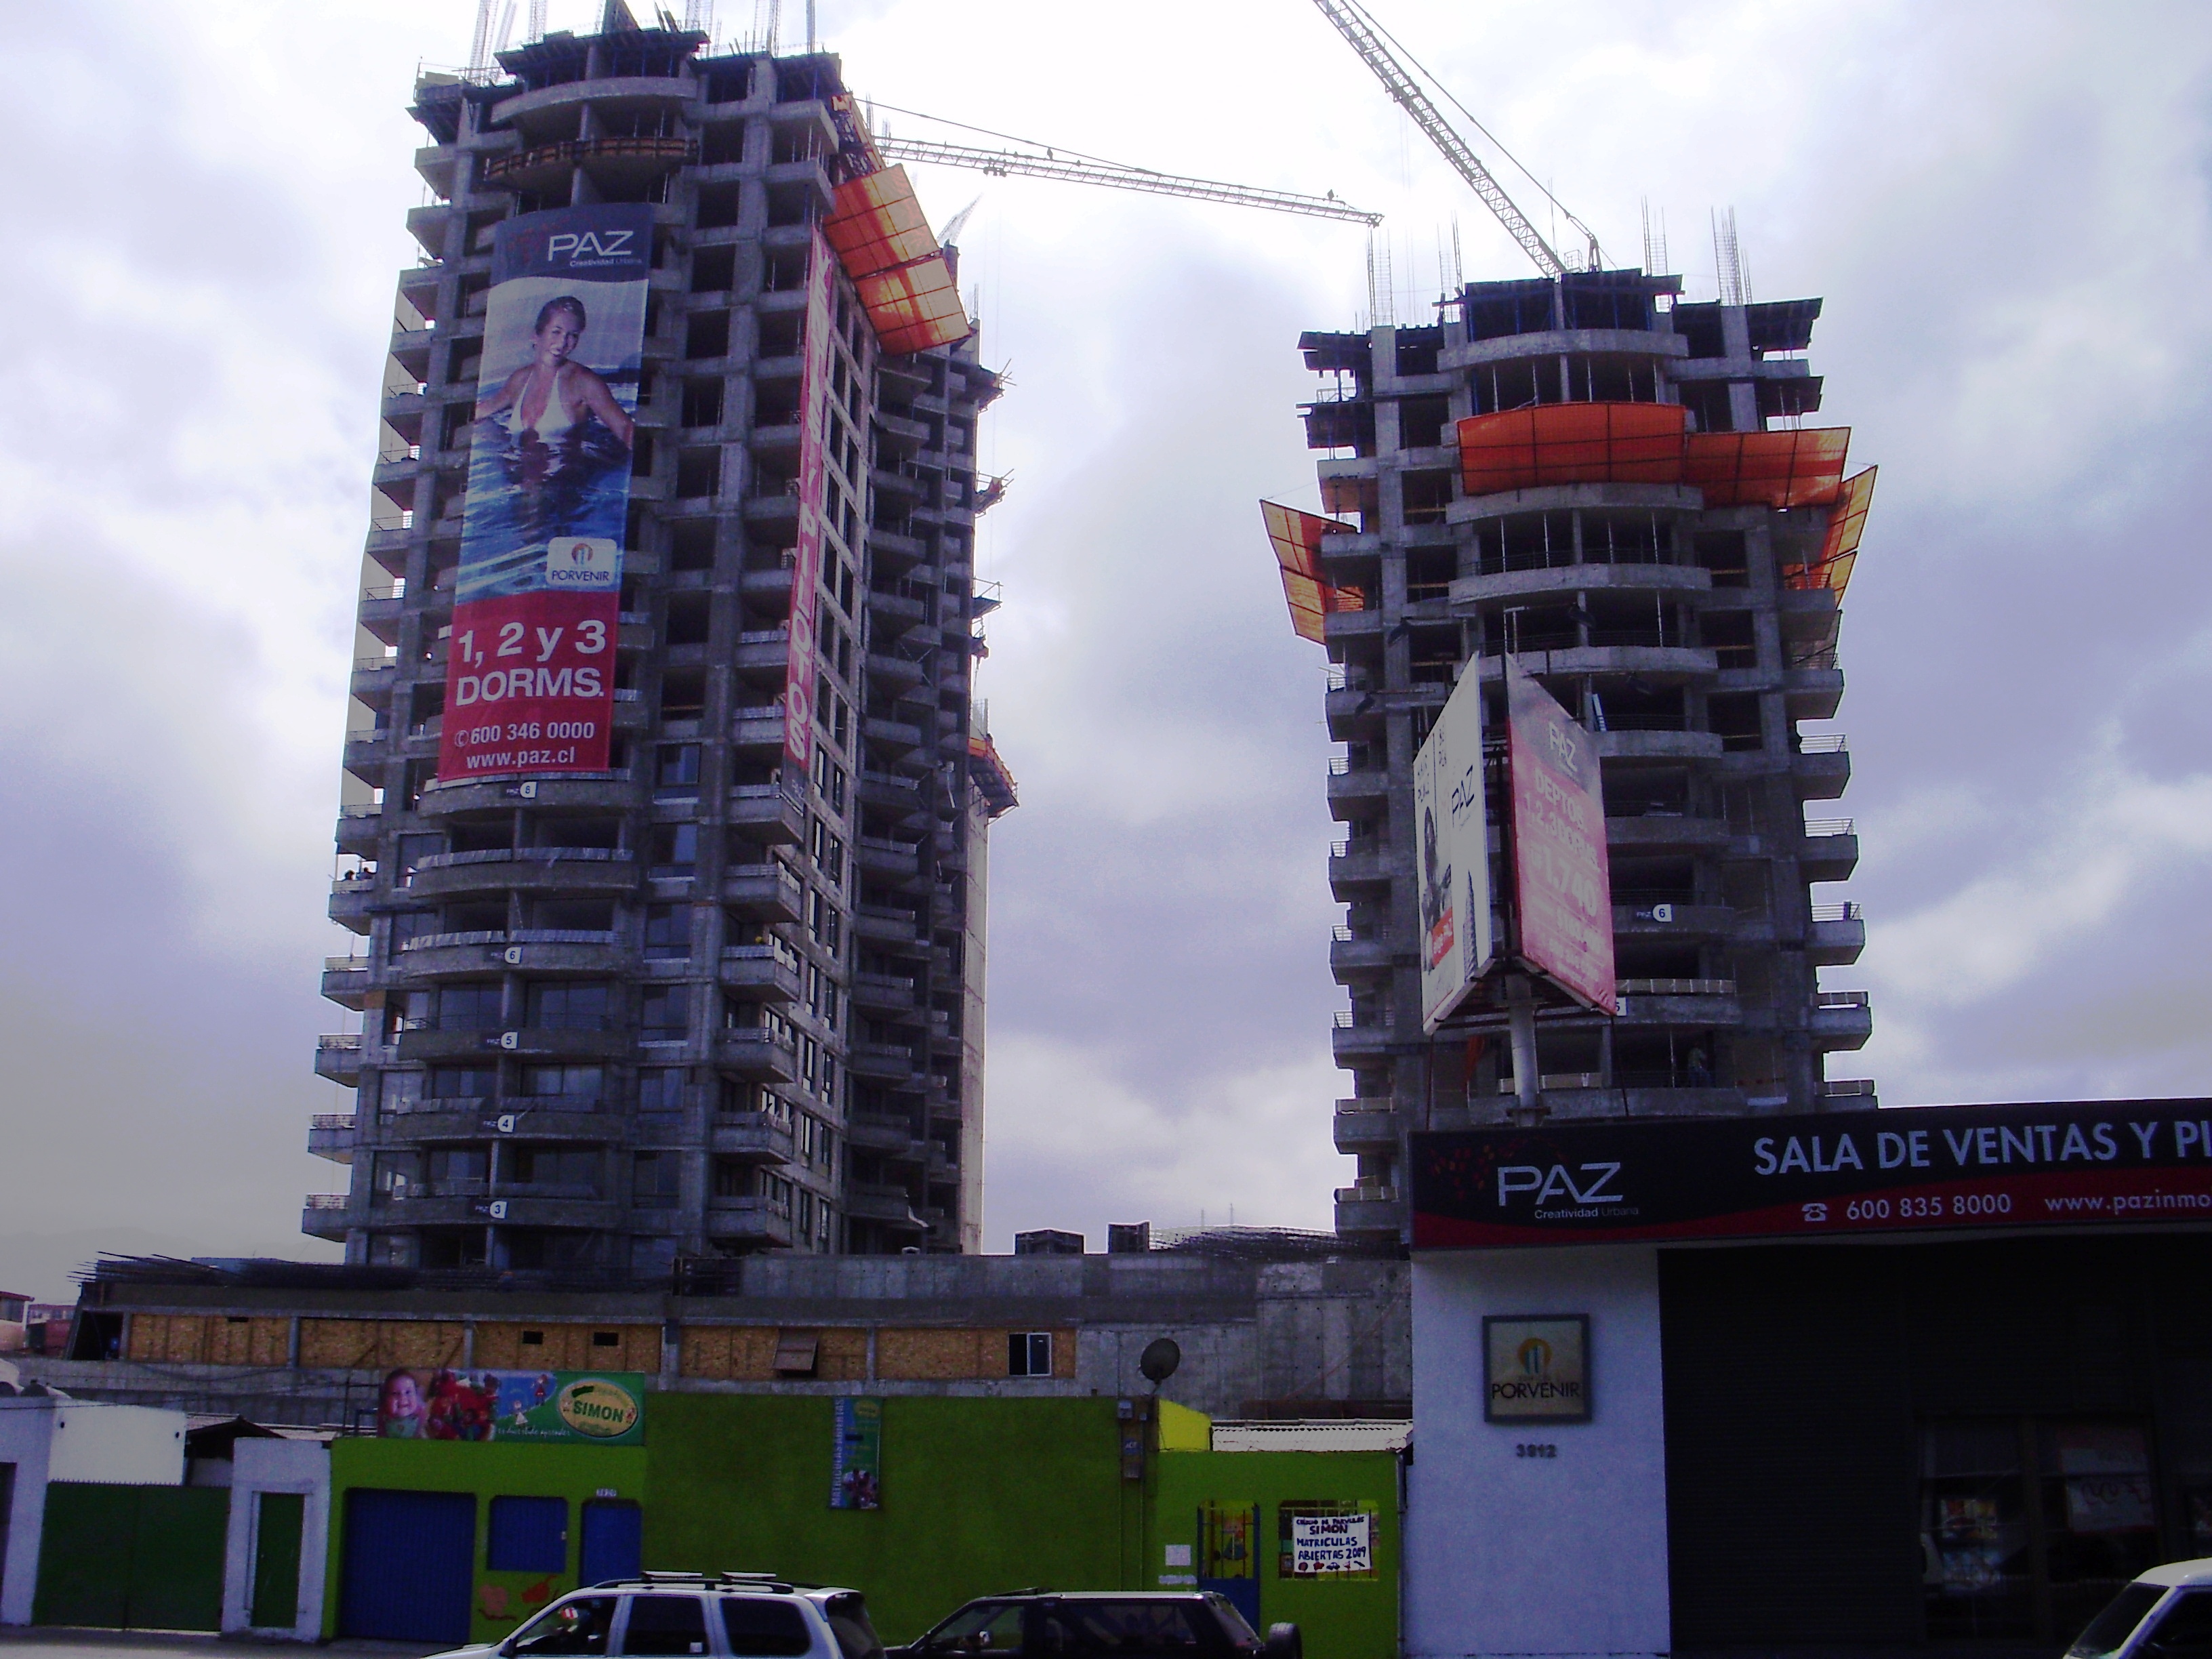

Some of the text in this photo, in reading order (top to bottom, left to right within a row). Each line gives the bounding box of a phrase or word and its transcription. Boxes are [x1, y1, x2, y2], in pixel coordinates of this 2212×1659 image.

[548, 230, 634, 262] PAZ
[552, 569, 609, 582] PORVENIR
[458, 619, 607, 668] 1, 2 y 3
[455, 667, 605, 706] DORMS.
[507, 723, 541, 741] 346
[547, 722, 595, 739] 0000
[1549, 721, 1578, 773] PAZ
[466, 746, 575, 769] www.paz.cl
[525, 785, 531, 794] 8
[1452, 765, 1475, 828] PAZ
[1658, 908, 1666, 918] 6
[510, 950, 516, 960] 6
[506, 1036, 512, 1045] 5
[502, 1118, 509, 1128] 4
[1753, 1134, 1864, 1176] SALA
[1877, 1129, 1931, 1170] DE
[1942, 1122, 2118, 1166] VENTAS
[2129, 1121, 2158, 1159] Y
[1497, 1162, 1624, 1207] PAZ
[494, 1204, 501, 1214] 3
[1534, 1208, 1599, 1219] Creatividad
[1845, 1198, 1890, 1221] 600
[1899, 1196, 1943, 1218] 835
[1952, 1193, 2011, 1215] 8000
[1491, 1382, 1581, 1399] PORVENIR
[573, 1400, 624, 1423] SIMON
[1309, 1524, 1348, 1535] SIMON
[1296, 1536, 1358, 1547] MATRICULAS
[1298, 1546, 1366, 1561] ABIERTAS 2009
